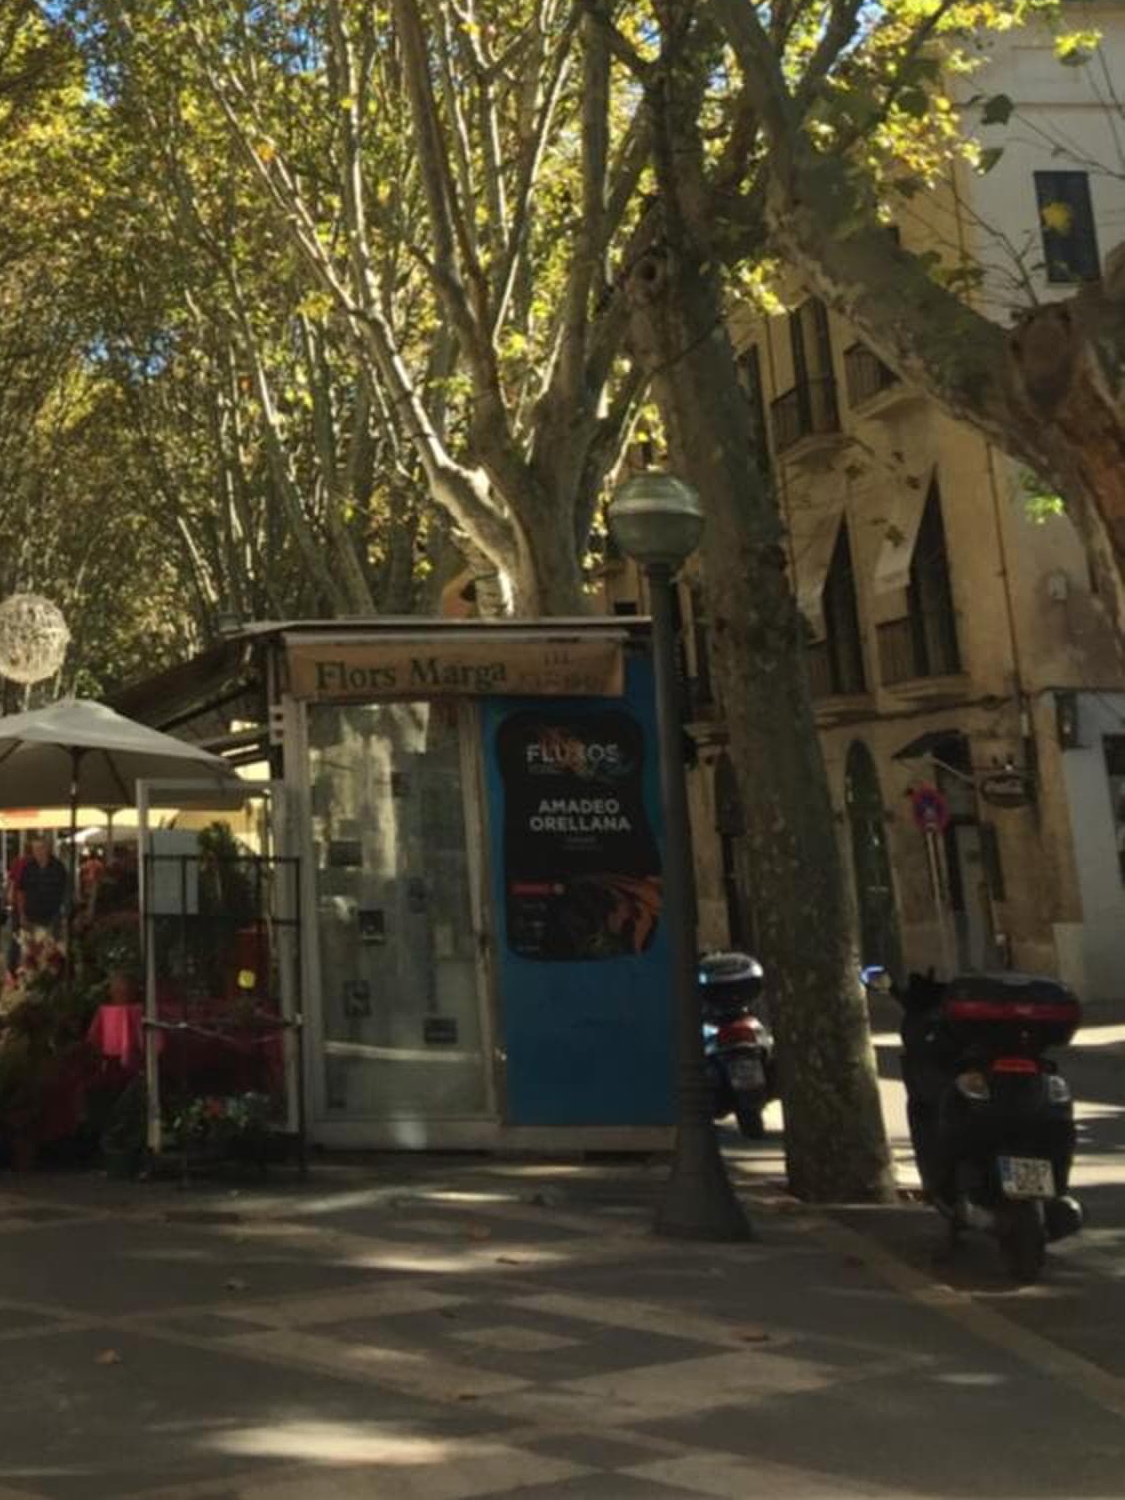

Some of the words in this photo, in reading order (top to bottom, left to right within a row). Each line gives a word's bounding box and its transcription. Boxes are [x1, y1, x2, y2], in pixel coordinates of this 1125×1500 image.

[315, 660, 396, 690] Flors
[411, 657, 507, 691] Marga
[538, 799, 620, 815] AMADEO
[530, 815, 630, 832] ORELLANA
